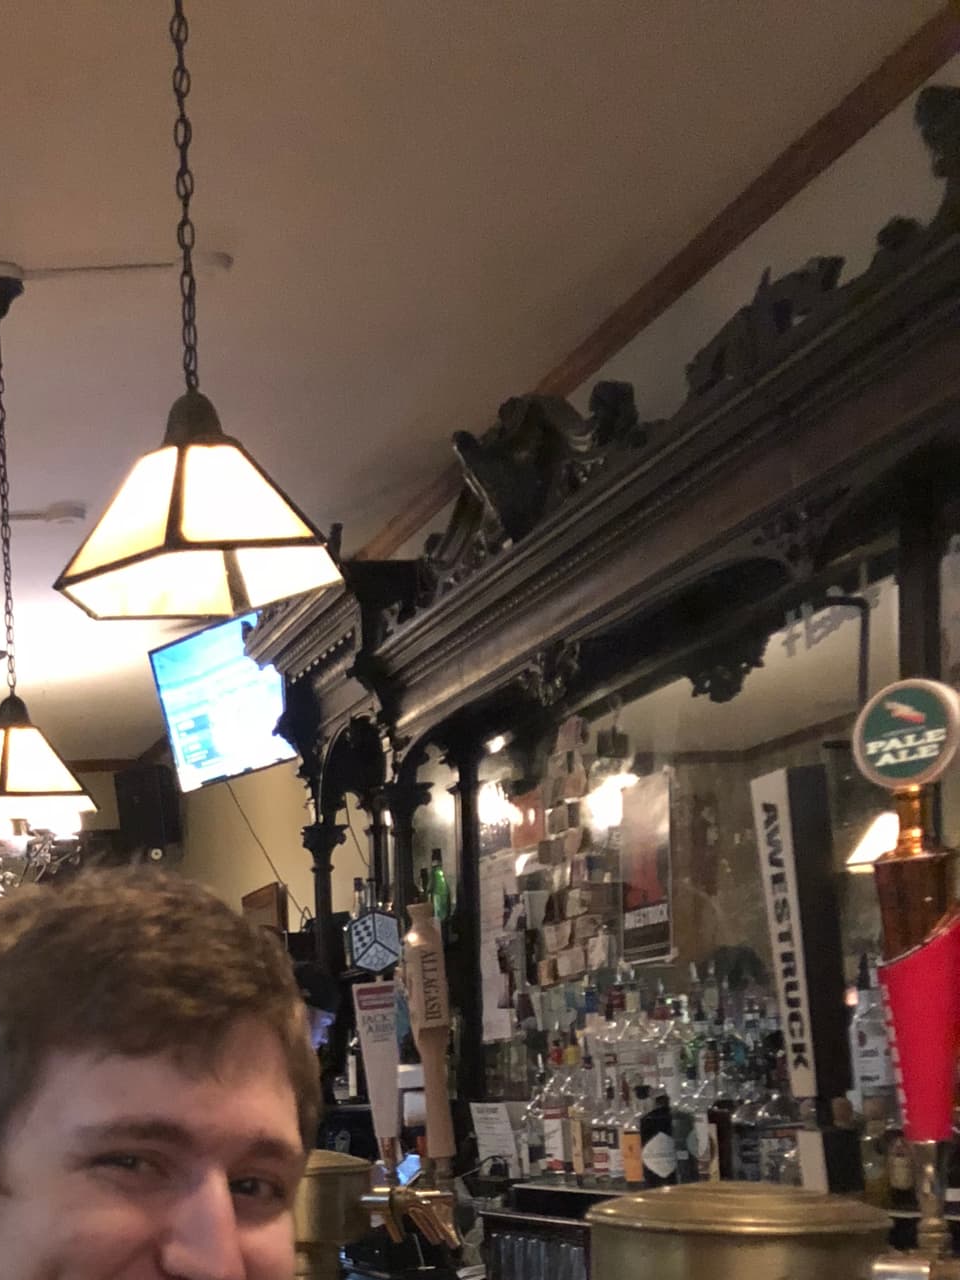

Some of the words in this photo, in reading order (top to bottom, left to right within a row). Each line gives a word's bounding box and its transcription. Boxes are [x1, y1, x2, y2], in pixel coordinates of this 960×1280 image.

[866, 728, 947, 755] PALE
[874, 743, 940, 767] ALE
[762, 802, 809, 1070] AWESTRUCK
[421, 950, 442, 1021] ALLAGASH
